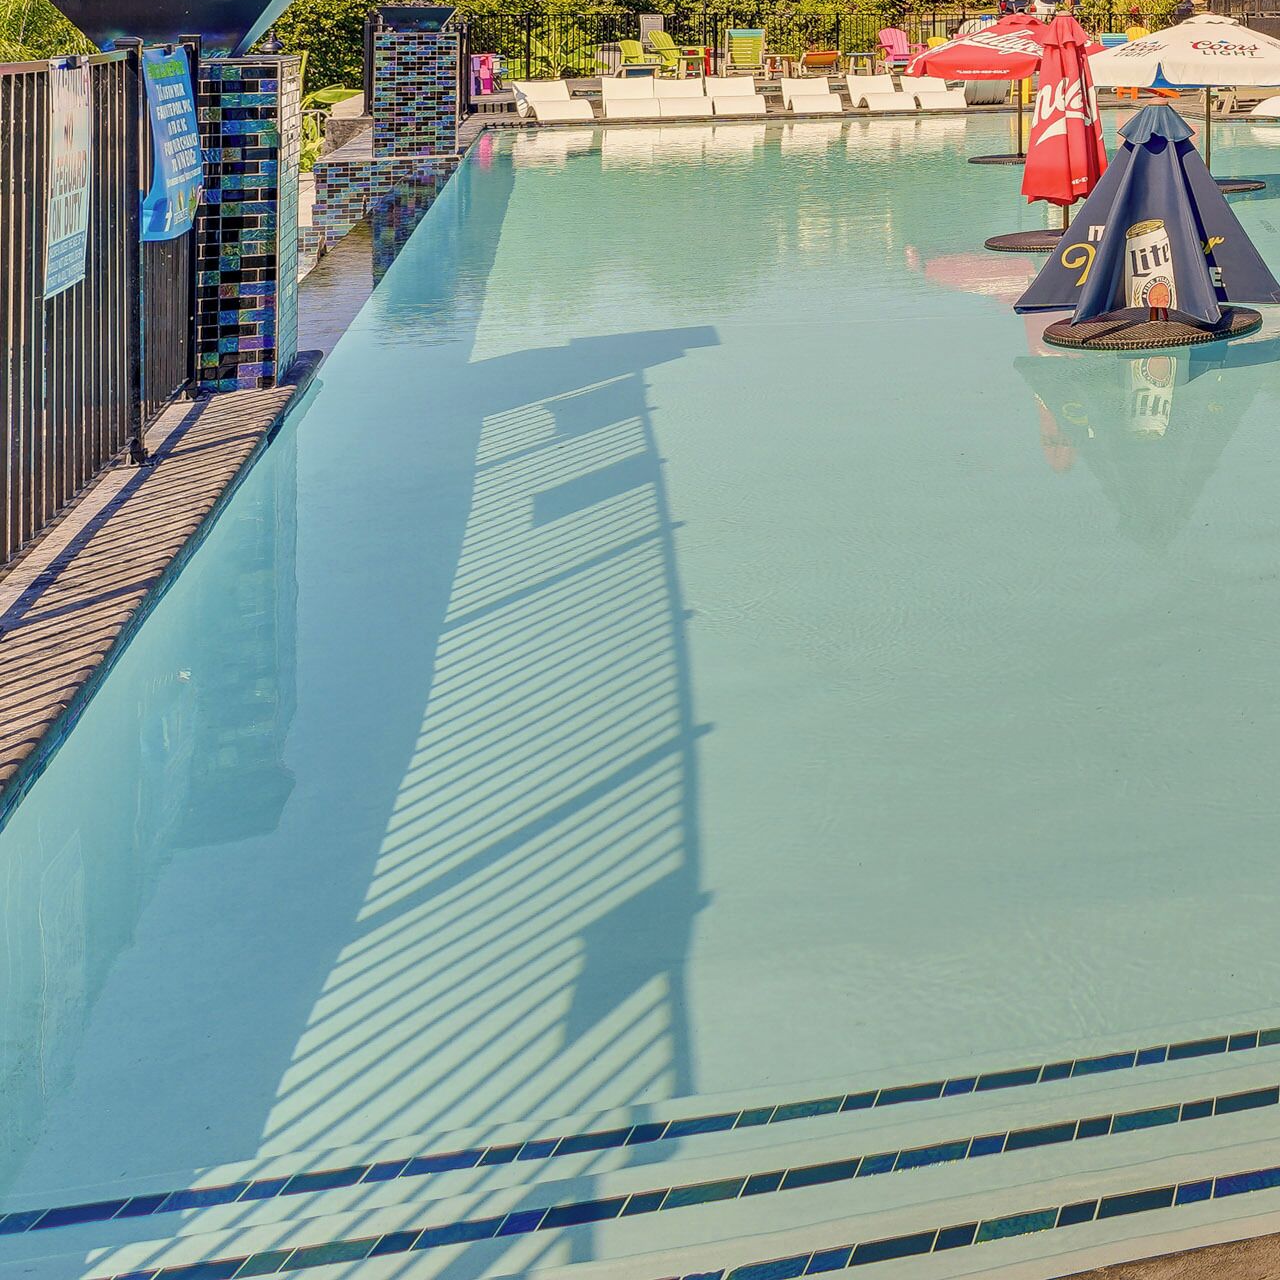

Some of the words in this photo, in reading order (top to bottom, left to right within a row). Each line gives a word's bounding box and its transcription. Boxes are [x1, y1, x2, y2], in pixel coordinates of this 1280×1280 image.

[1190, 39, 1260, 51] Coors
[64, 114, 74, 146] NO
[51, 149, 86, 199] LIFEGUARD
[64, 191, 82, 235] DUTY
[1088, 225, 1105, 242] IT
[1129, 242, 1169, 276] Lite
